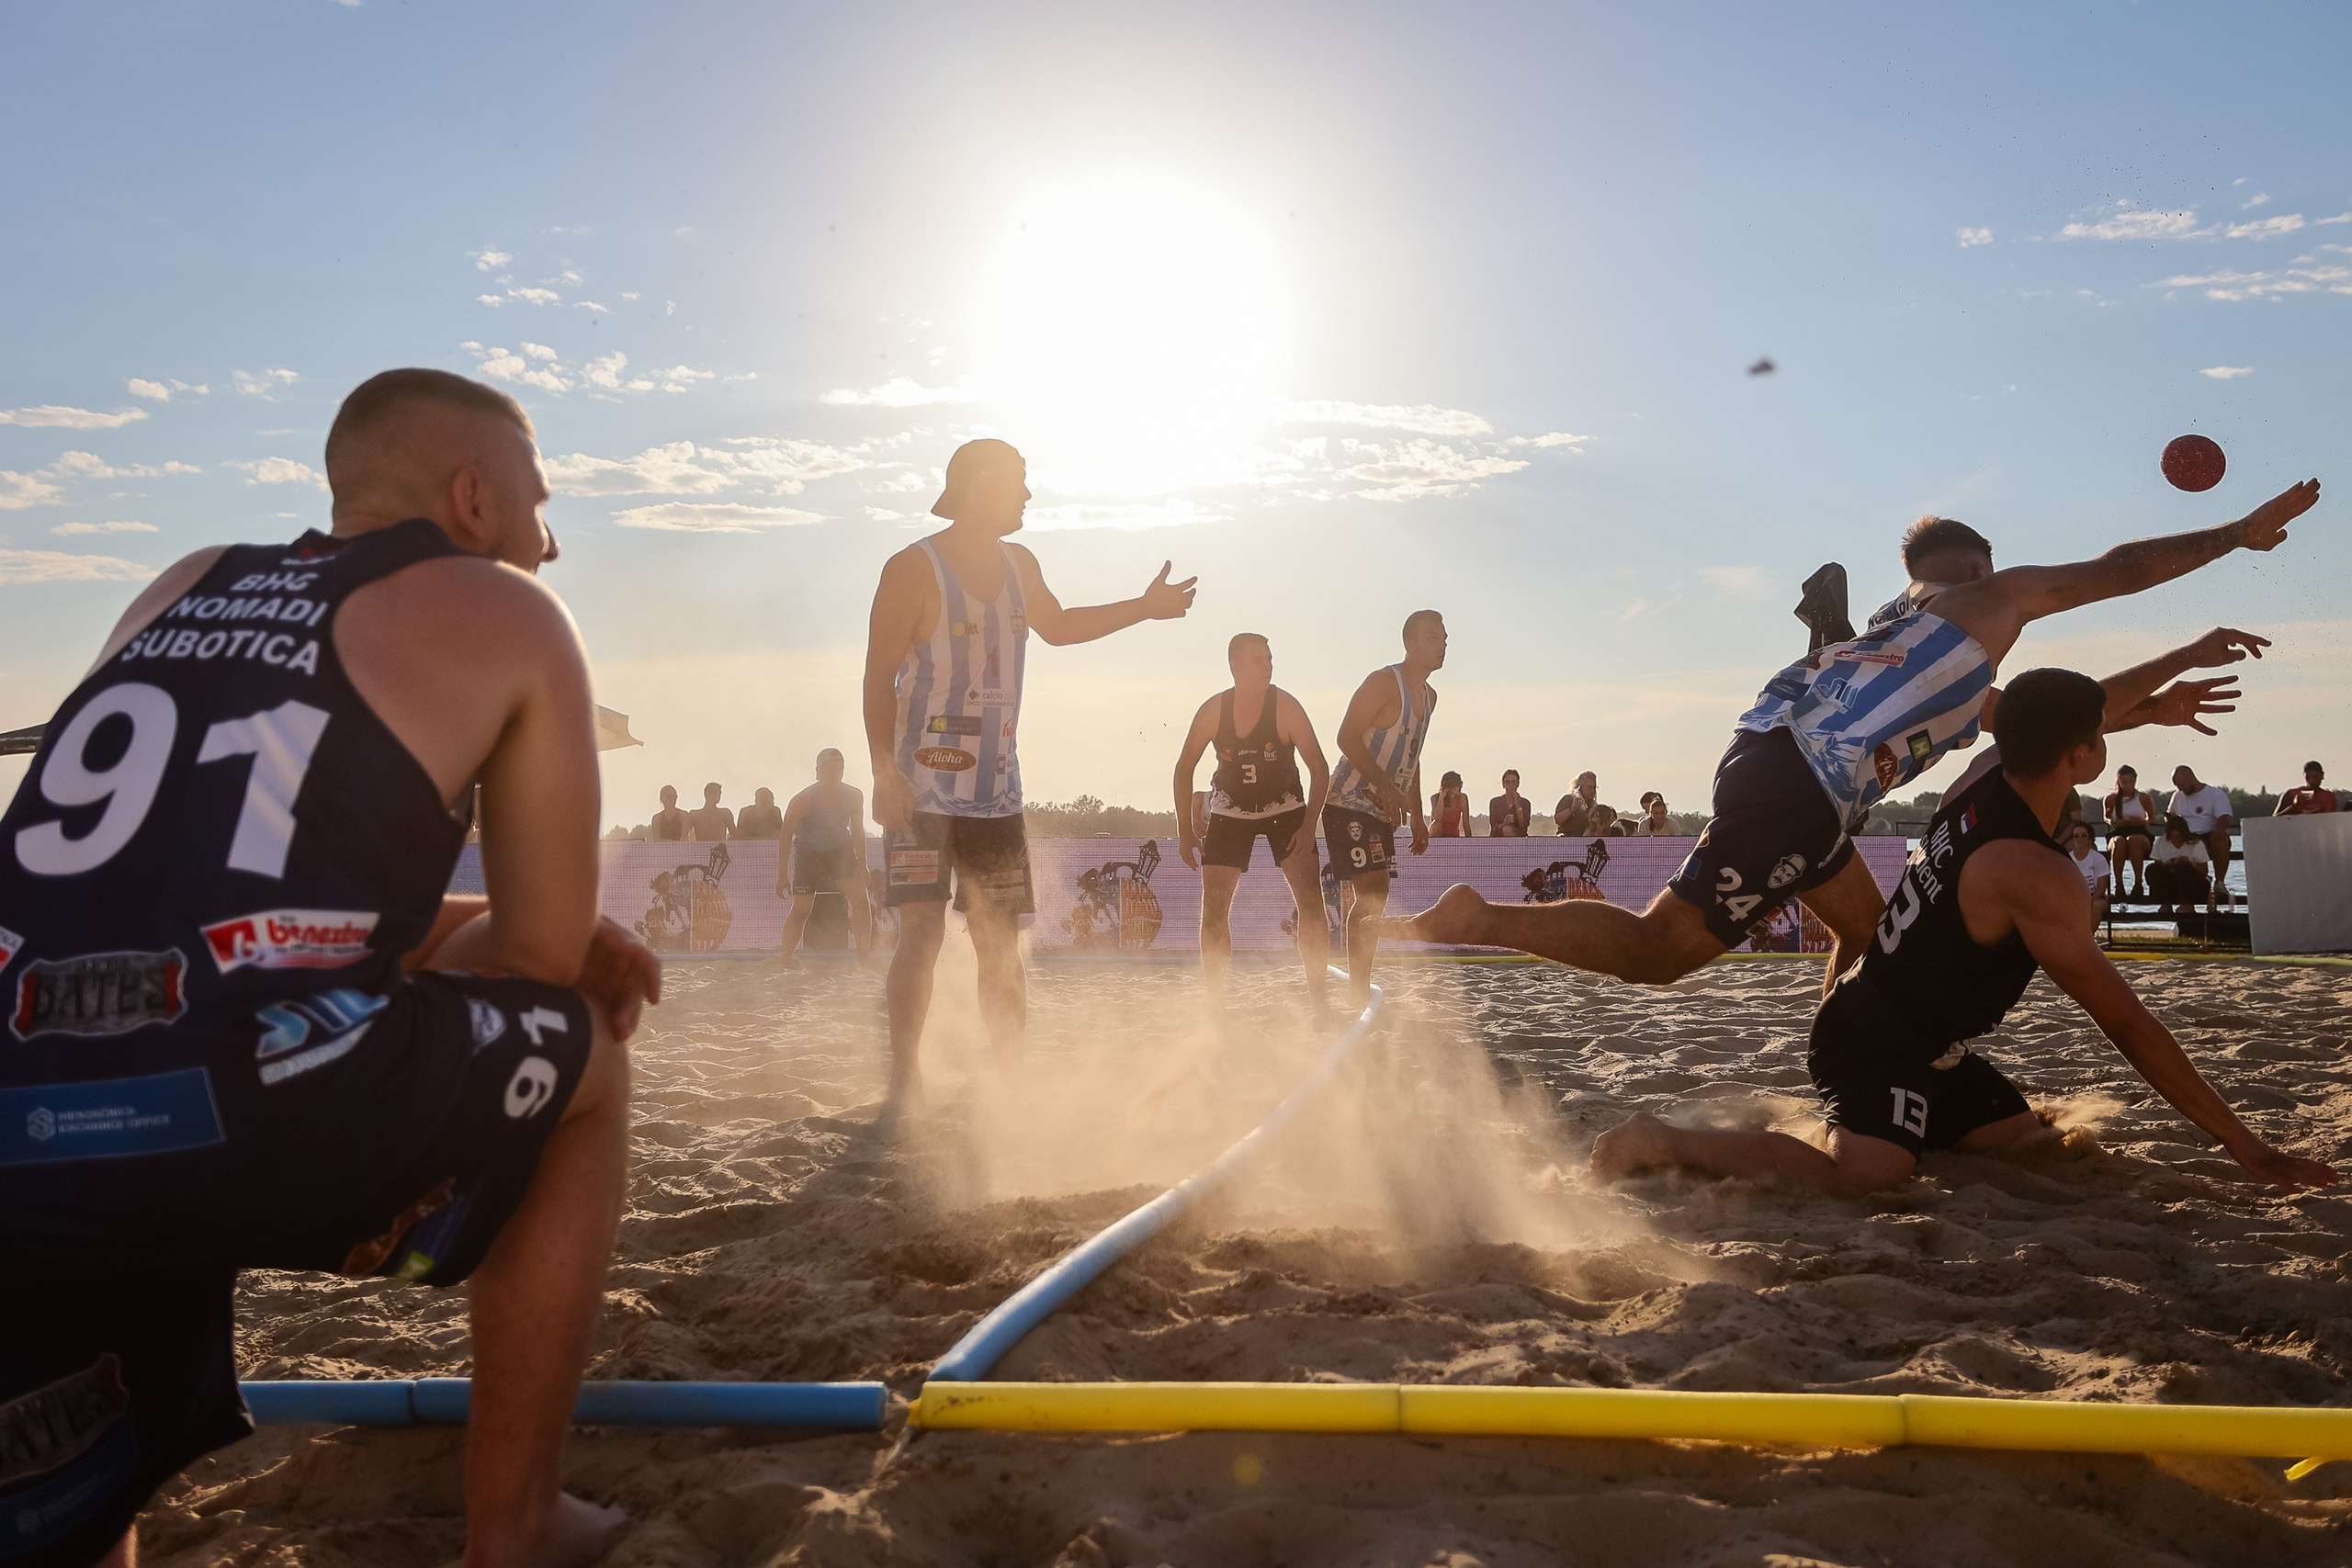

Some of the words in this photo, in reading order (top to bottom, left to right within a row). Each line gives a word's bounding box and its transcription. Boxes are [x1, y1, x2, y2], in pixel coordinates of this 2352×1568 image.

[167, 596, 329, 627] NOMADI
[120, 628, 320, 676] SUBOTICA
[982, 690, 1003, 699] calcio
[14, 682, 331, 880] 91
[928, 750, 963, 764] Aloha
[1241, 764, 1257, 784] 3
[1350, 847, 1367, 868] 9
[1931, 820, 1953, 869] BHC
[1715, 867, 1764, 922] 24
[503, 1006, 569, 1120] 91
[1890, 1086, 1929, 1139] 13
